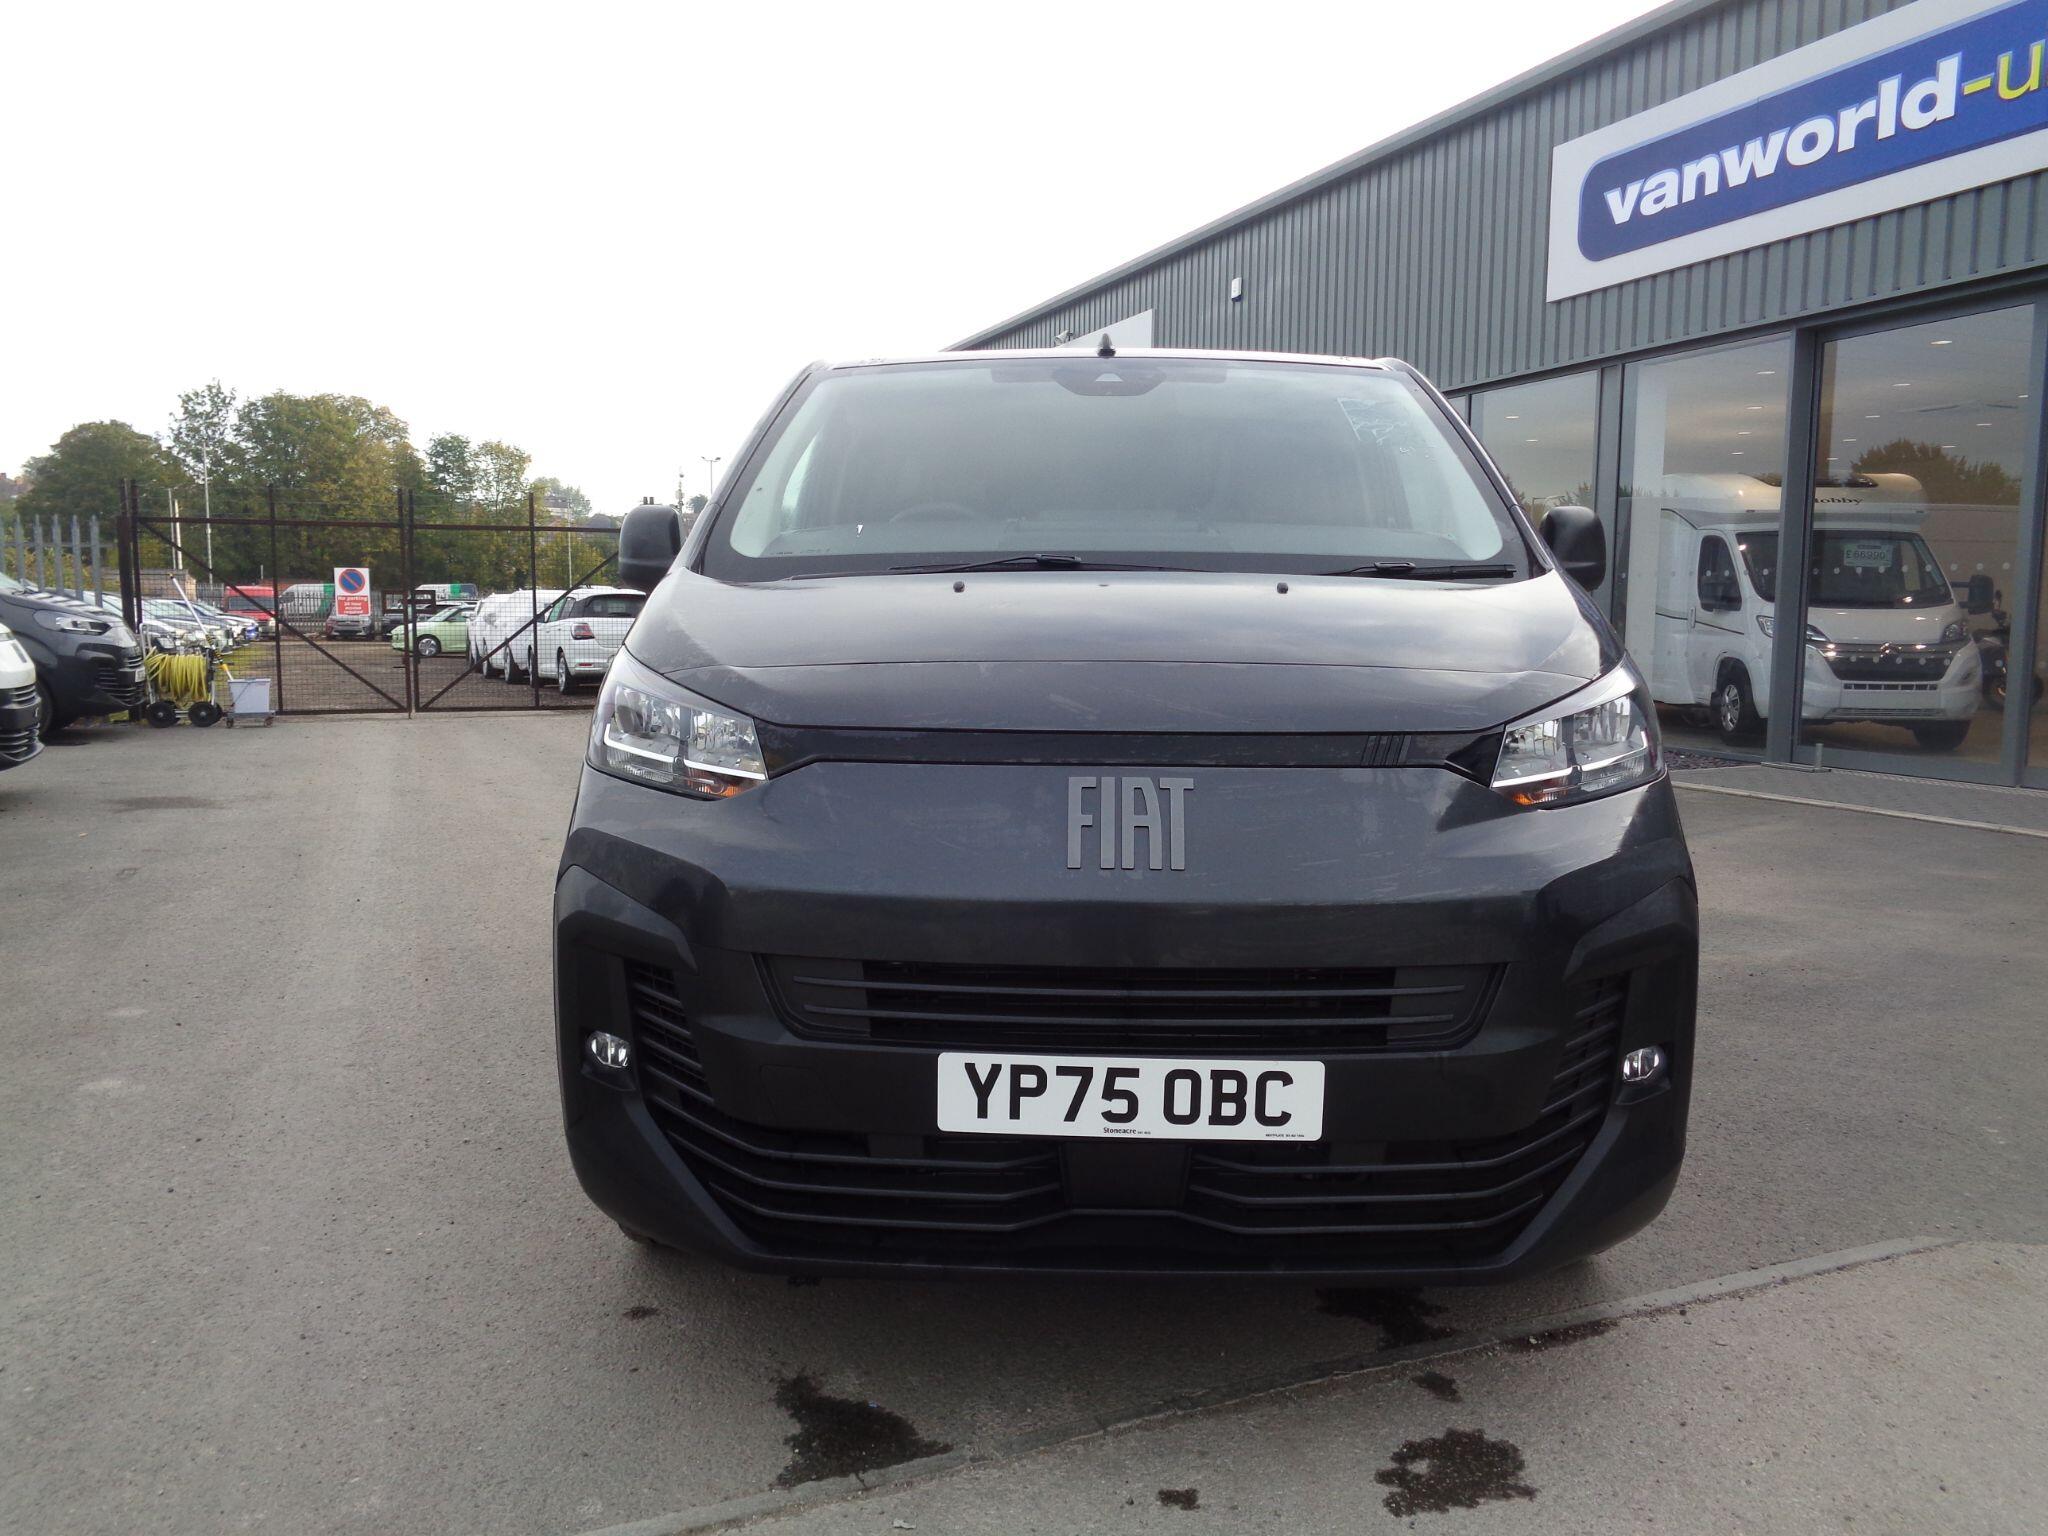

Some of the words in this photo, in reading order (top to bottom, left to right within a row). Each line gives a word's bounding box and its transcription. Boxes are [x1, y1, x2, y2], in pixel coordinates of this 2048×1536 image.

[1604, 40, 2048, 224] vanworld-u
[1067, 776, 1194, 870] FIAT
[964, 1063, 1140, 1124] YP75
[1163, 1069, 1293, 1127] OBC
[1103, 1126, 1137, 1135] Stoneacre
